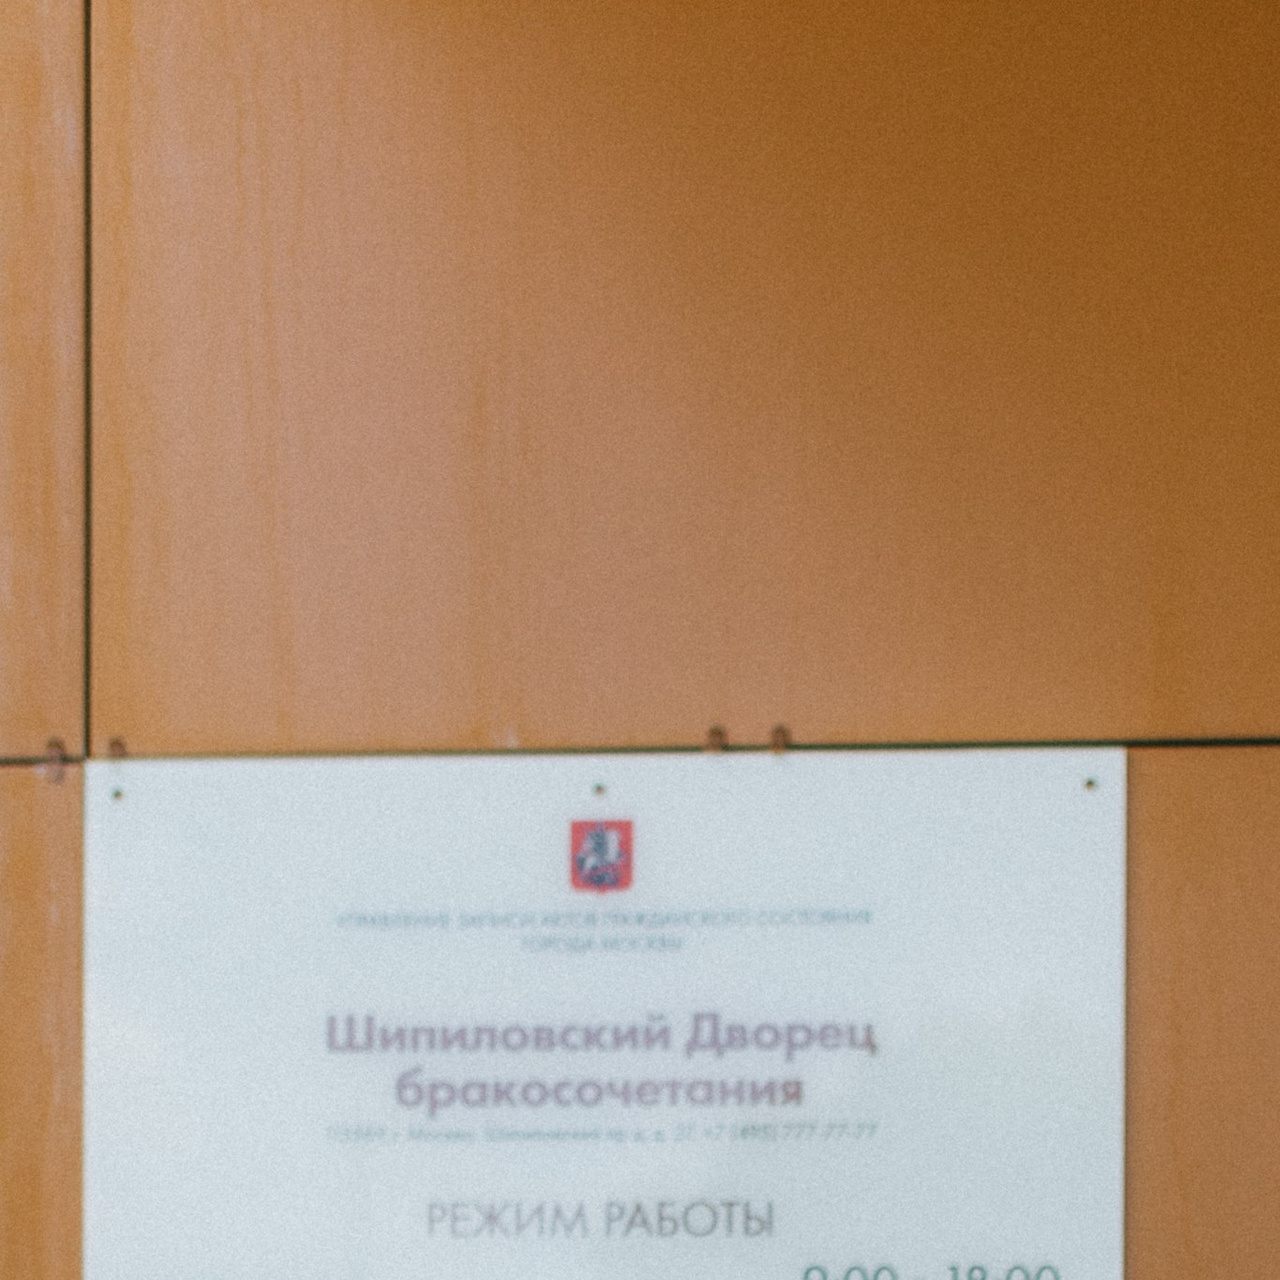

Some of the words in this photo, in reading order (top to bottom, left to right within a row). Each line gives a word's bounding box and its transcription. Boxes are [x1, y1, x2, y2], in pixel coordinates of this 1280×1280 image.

[325, 1013, 673, 1054] Шипиловский
[685, 1011, 879, 1062] Дворец
[394, 1066, 807, 1118] бракосочетания
[426, 1202, 588, 1239] РЕЖИМ
[604, 1201, 775, 1238] РАБОТЫ
